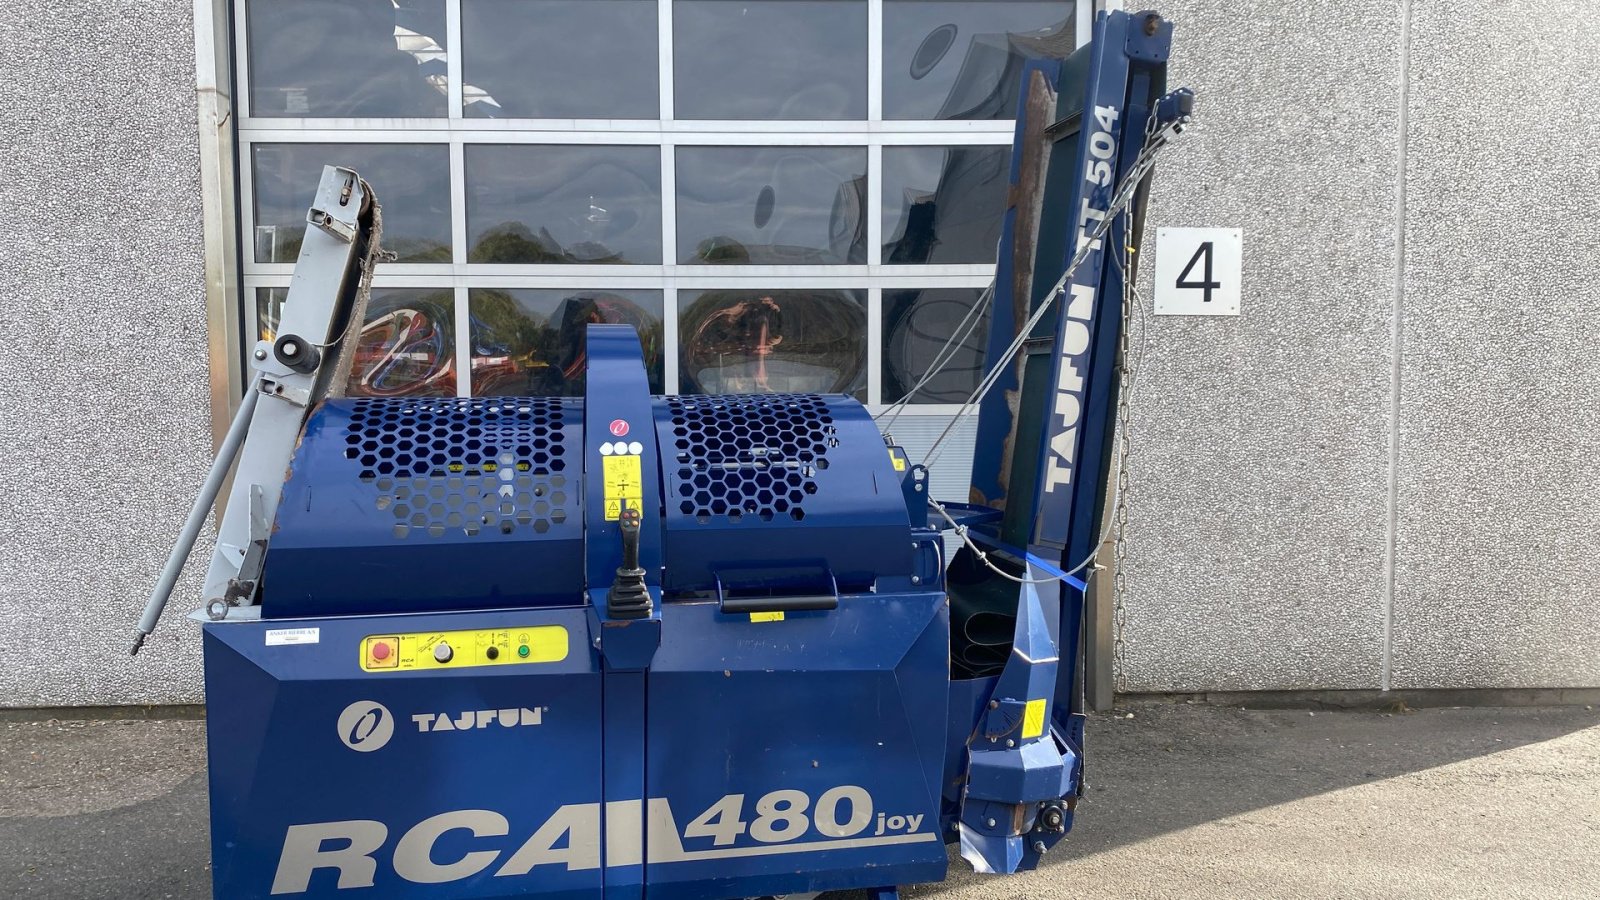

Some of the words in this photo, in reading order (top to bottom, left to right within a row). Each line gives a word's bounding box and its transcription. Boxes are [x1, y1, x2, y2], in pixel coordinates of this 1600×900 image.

[1045, 283, 1095, 493] TAJFUN
[1085, 105, 1119, 188] 504
[1175, 241, 1221, 303] 4
[411, 706, 543, 733] TAJFUN
[270, 797, 685, 895] RCA
[683, 785, 874, 846] 480
[874, 812, 924, 836] joy
